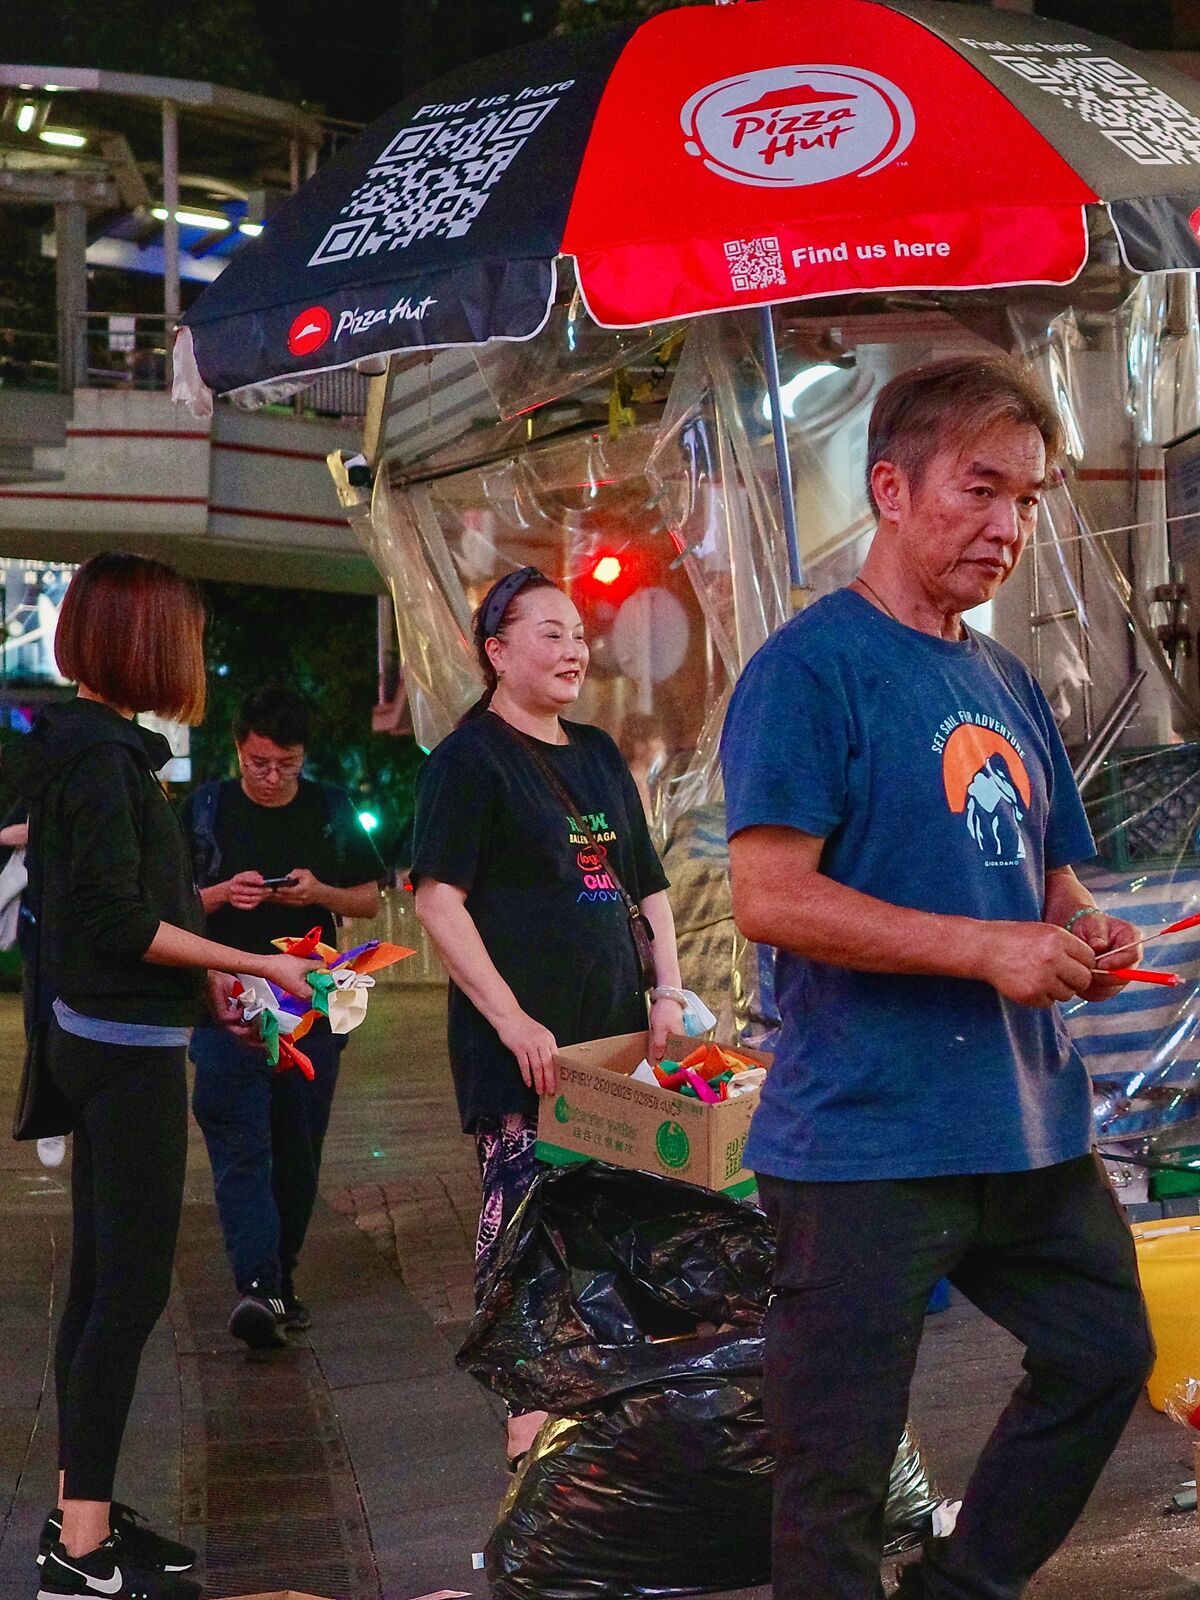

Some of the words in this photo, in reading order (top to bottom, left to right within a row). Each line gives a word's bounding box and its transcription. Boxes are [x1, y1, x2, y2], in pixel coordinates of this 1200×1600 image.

[412, 98, 476, 121] Find
[477, 94, 510, 109] us
[514, 79, 576, 101] here
[732, 107, 857, 149] Pizza
[758, 125, 856, 165] Hut
[791, 242, 848, 268] Find
[856, 243, 887, 260] us
[894, 239, 950, 257] here
[334, 306, 387, 342] Pizza
[388, 295, 438, 324] Hut
[931, 731, 946, 754] SET
[939, 715, 959, 735] SAIL
[975, 713, 1026, 759] ADVENTURE
[569, 831, 616, 845] BALENAGA
[560, 1066, 593, 1087] EXPIRY
